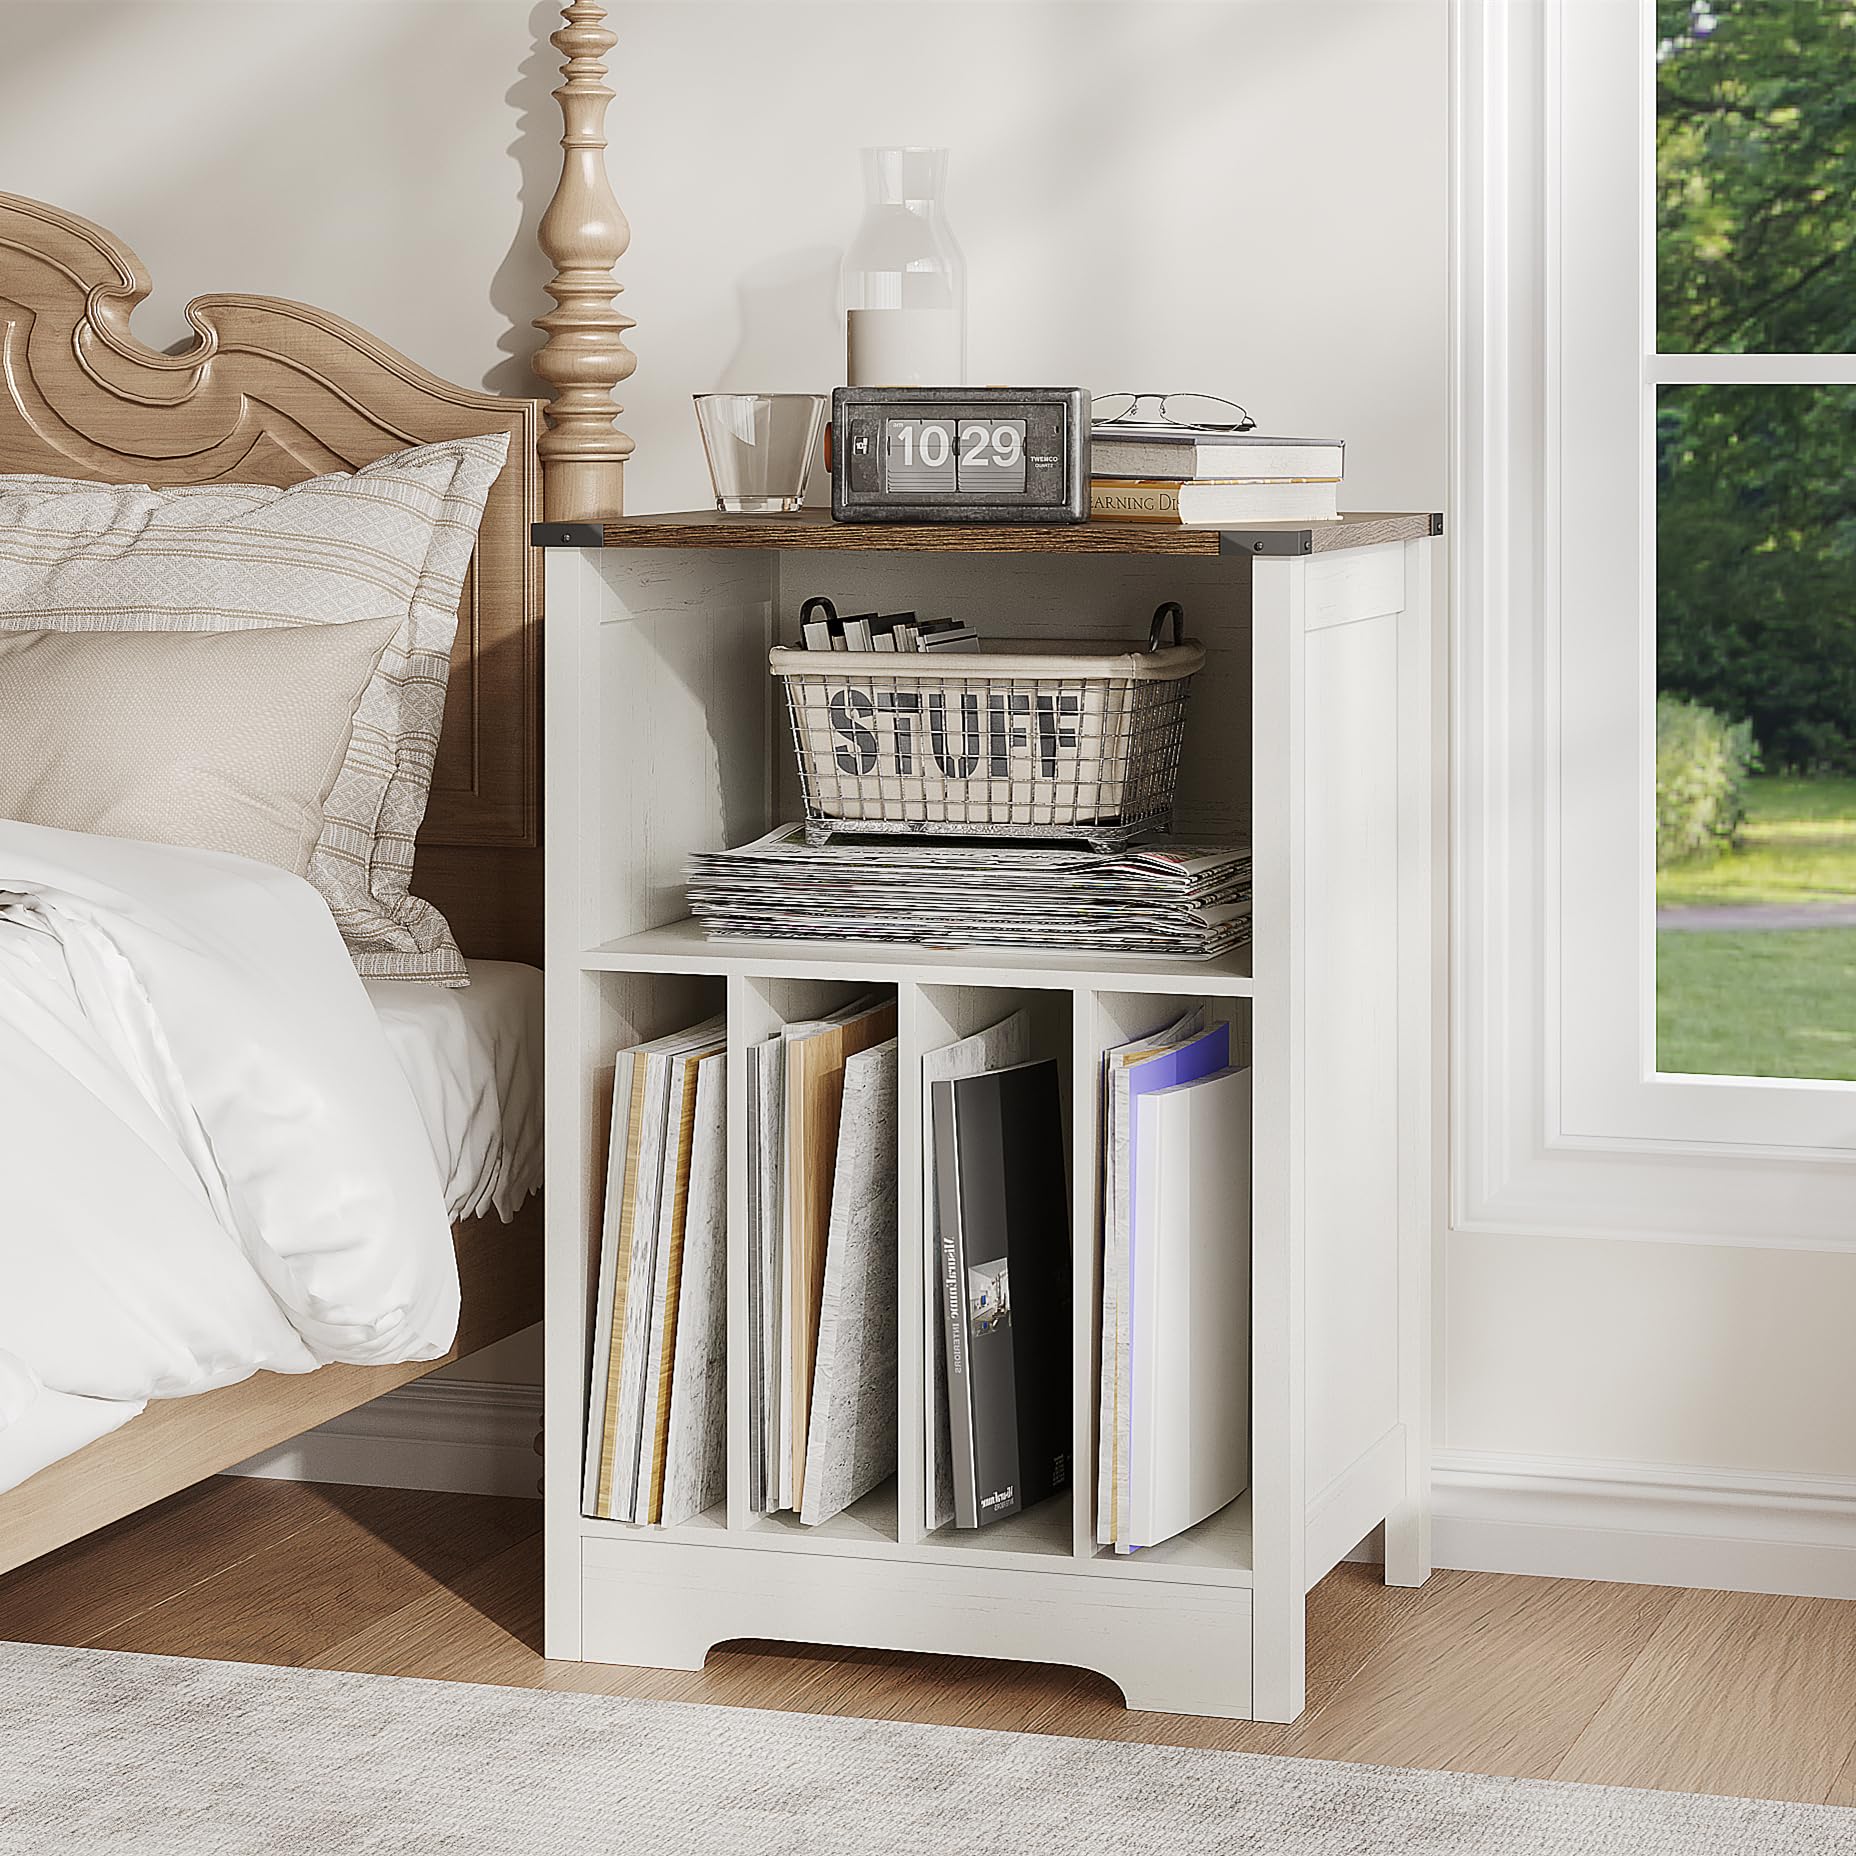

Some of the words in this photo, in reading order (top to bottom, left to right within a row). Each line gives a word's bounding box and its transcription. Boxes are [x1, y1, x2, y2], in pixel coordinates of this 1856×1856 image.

[898, 425, 950, 467] 10
[961, 425, 1021, 467] 29
[829, 689, 1080, 779] STUFF
